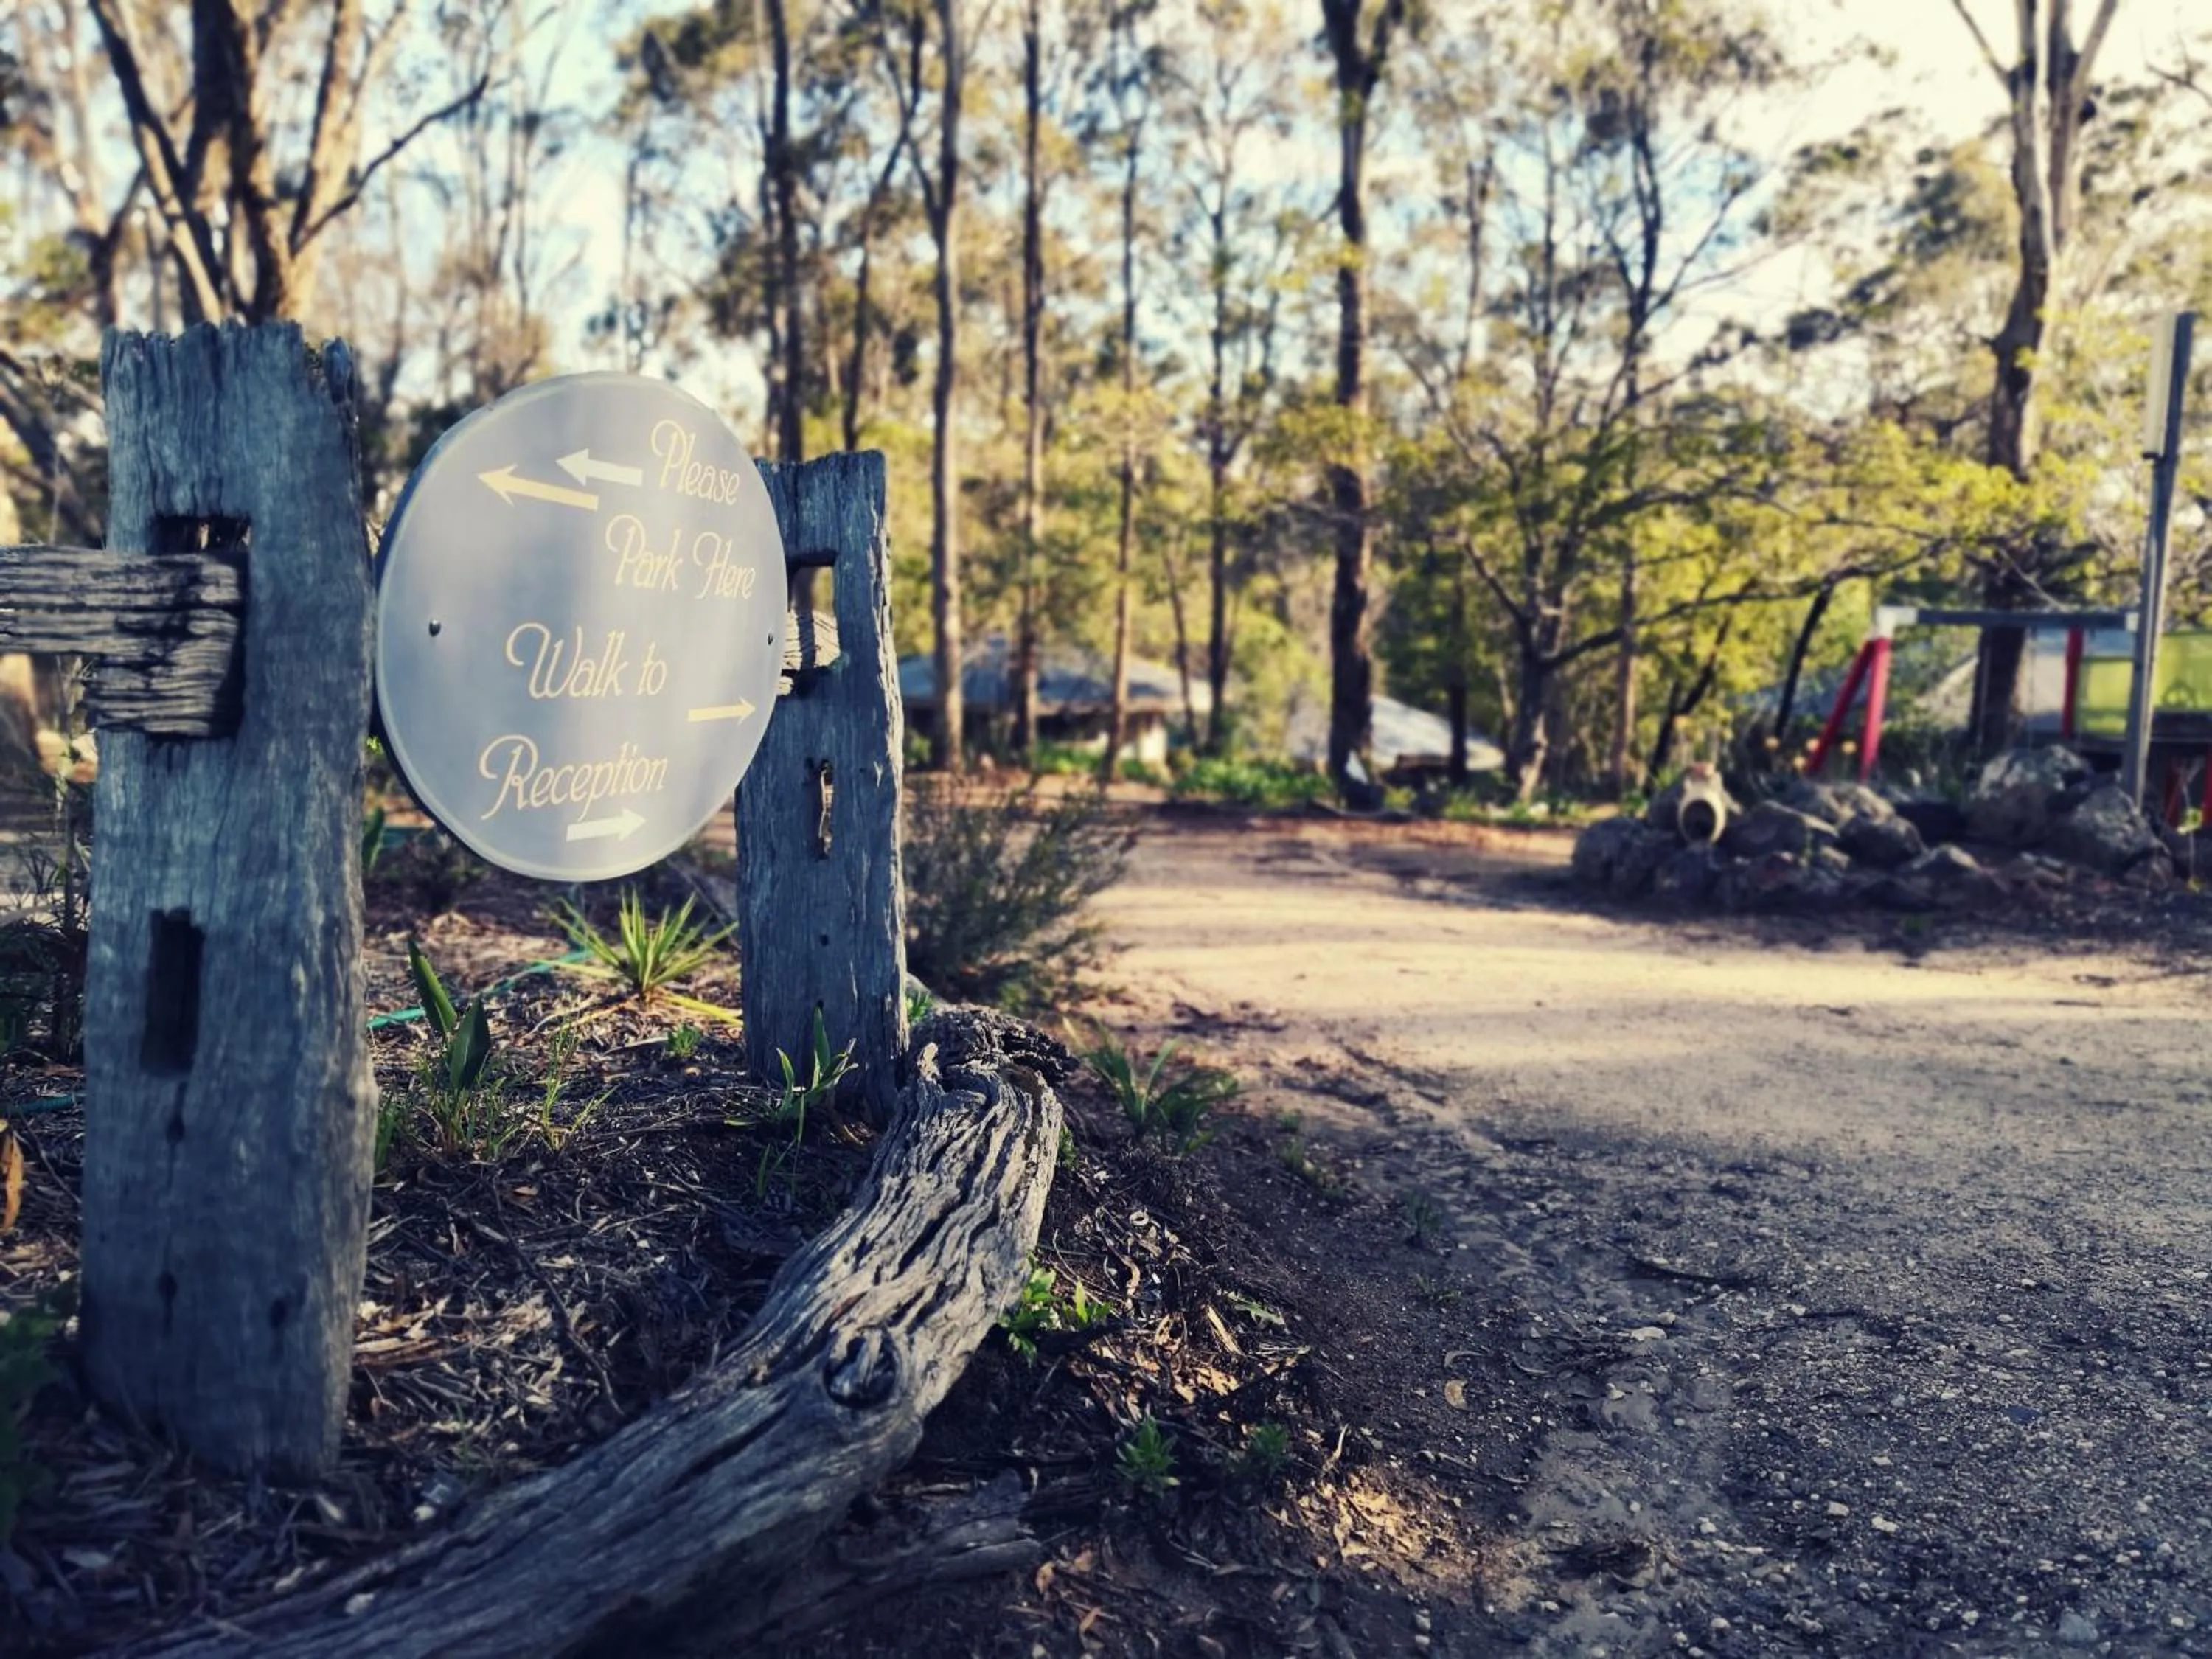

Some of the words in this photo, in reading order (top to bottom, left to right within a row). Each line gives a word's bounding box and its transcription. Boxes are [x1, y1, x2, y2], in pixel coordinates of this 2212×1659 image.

[651, 420, 740, 507] Please
[605, 513, 682, 591] Park
[694, 531, 756, 599] Here
[506, 622, 628, 699] Walk
[636, 642, 667, 695] to
[479, 734, 668, 821] Reception
